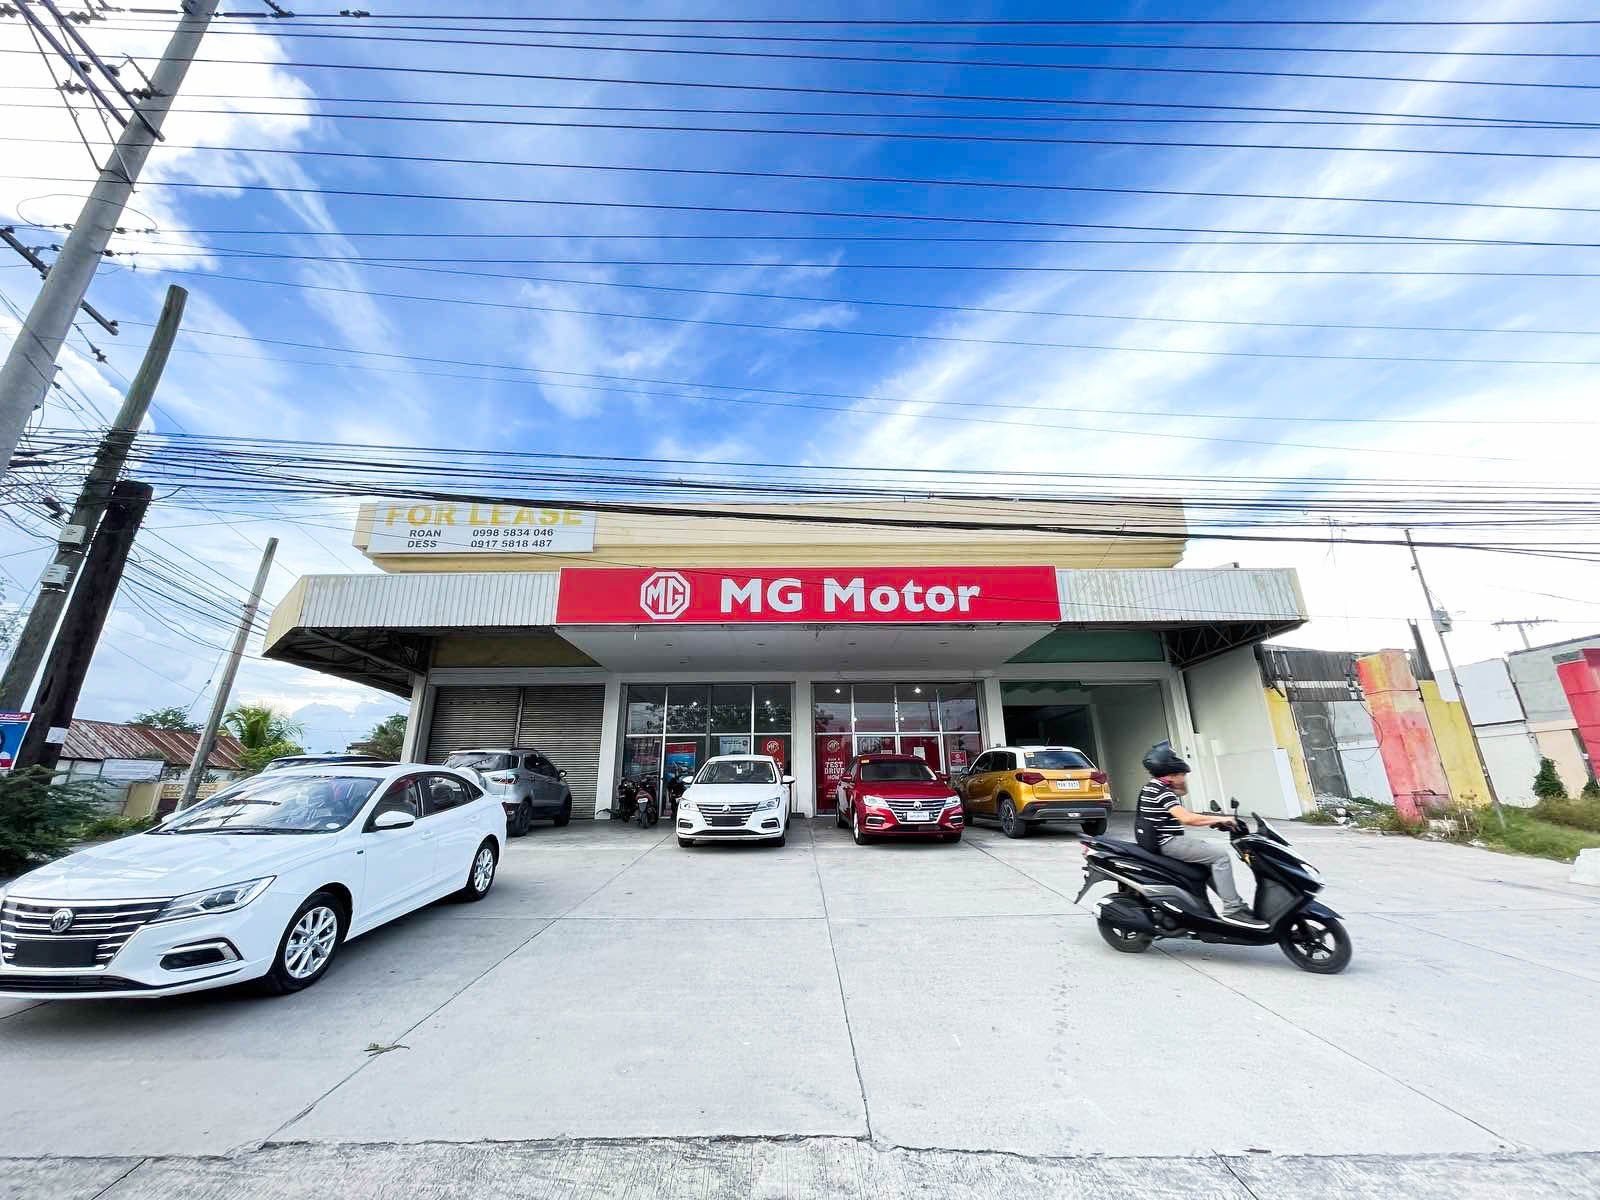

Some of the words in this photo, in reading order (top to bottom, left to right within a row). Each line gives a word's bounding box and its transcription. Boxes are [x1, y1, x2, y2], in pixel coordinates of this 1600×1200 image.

[385, 504, 455, 526] FOR
[469, 502, 582, 525] LEASE
[407, 540, 438, 548] DESS
[470, 539, 498, 548] 0917
[501, 539, 529, 548] 5818
[532, 539, 552, 548] 487
[409, 529, 441, 538] ROAN
[472, 528, 500, 537] 0998
[503, 528, 530, 537] 5834
[533, 528, 554, 537] 046
[647, 577, 685, 614] MG
[720, 577, 803, 613] MG
[823, 577, 981, 613] Motor
